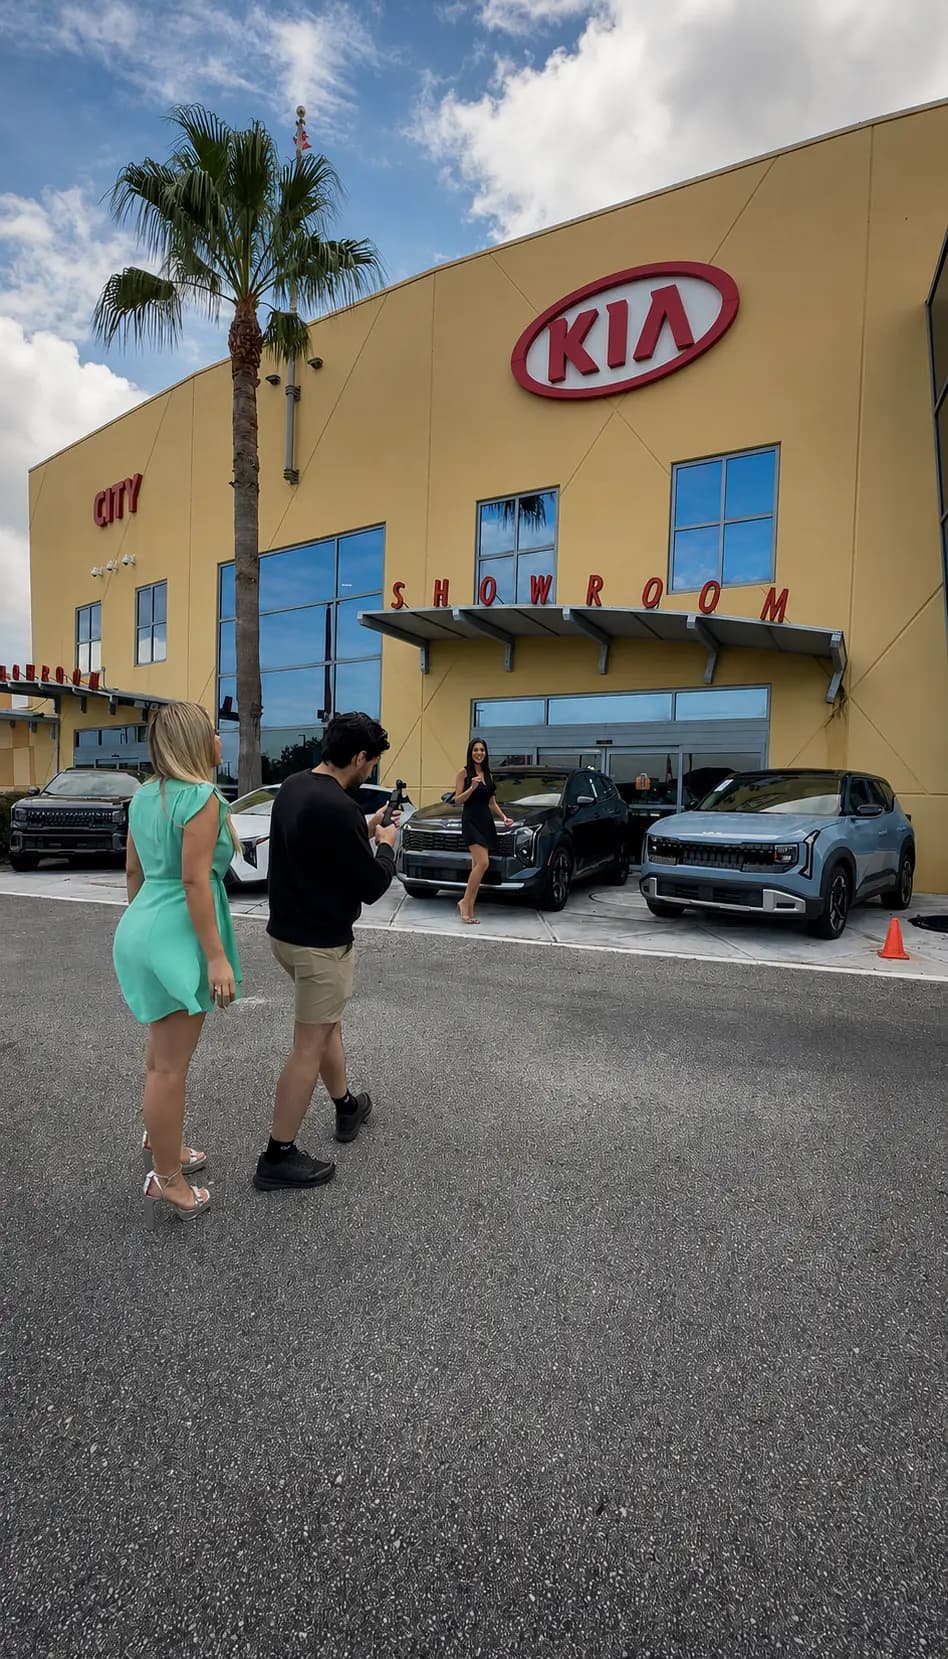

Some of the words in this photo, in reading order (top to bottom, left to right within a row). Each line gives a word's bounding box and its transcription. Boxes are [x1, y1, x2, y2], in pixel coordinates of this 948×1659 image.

[547, 284, 695, 384] KIA
[93, 473, 143, 527] CITY
[391, 575, 790, 623] SHOWROOM
